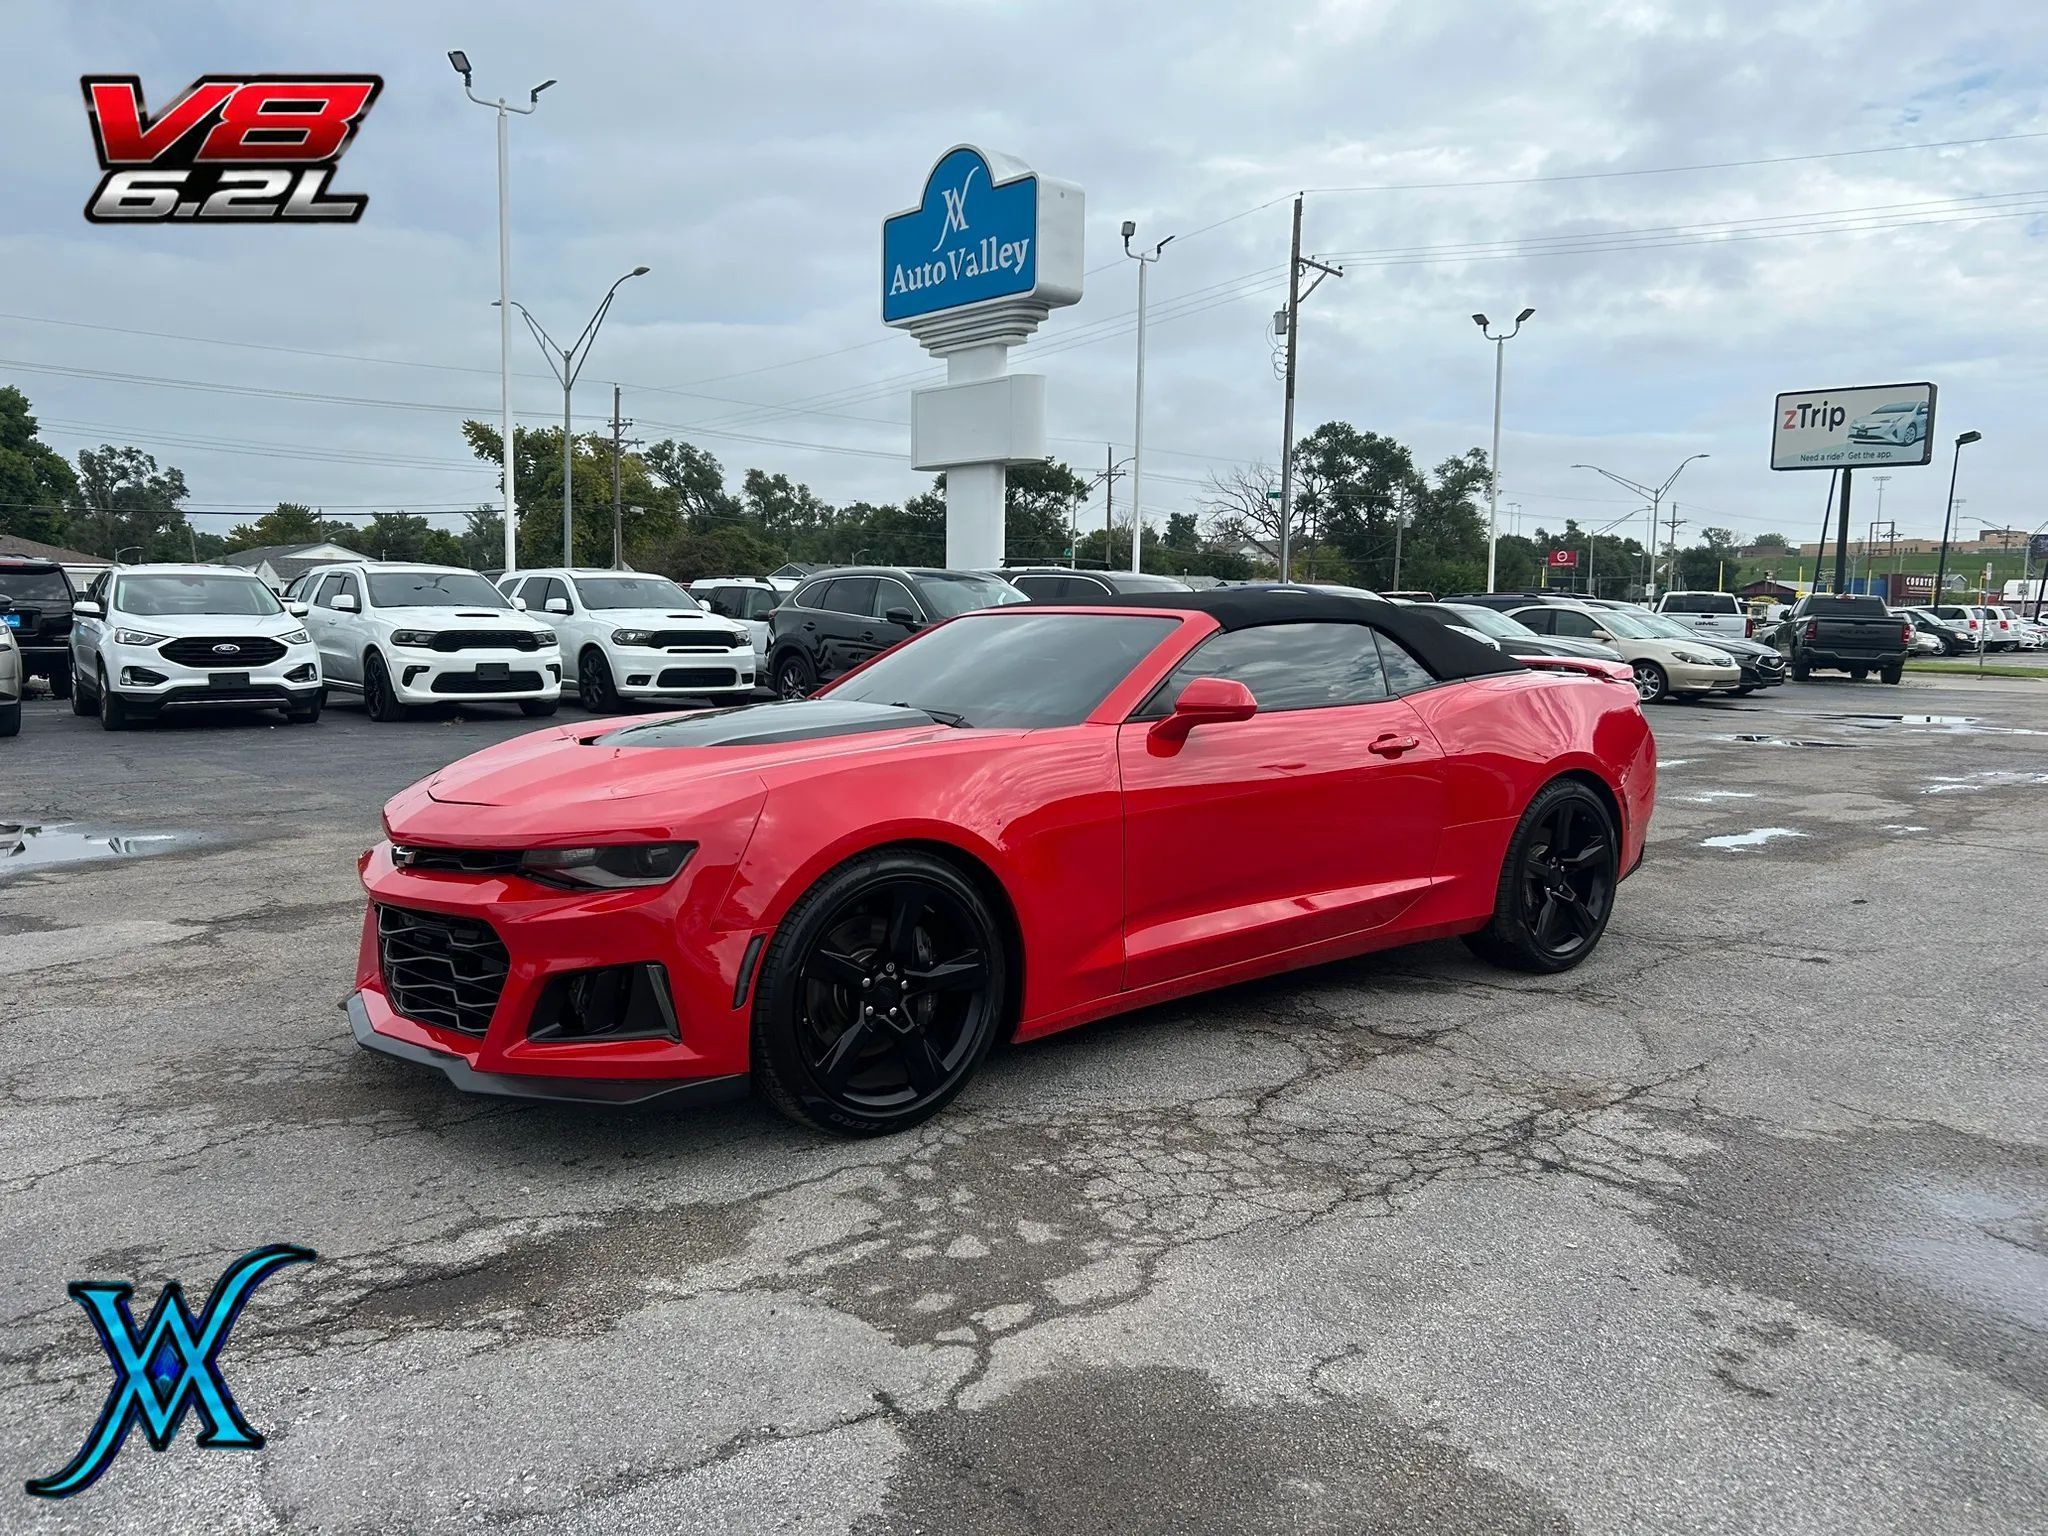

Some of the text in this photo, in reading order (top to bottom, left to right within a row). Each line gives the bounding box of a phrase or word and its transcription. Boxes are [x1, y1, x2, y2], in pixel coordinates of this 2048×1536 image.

[1783, 400, 1846, 432] zTrip
[1800, 453, 1819, 461] Need
[1827, 452, 1844, 460] ride?
[1848, 452, 1861, 460] Get
[1862, 451, 1875, 459] the
